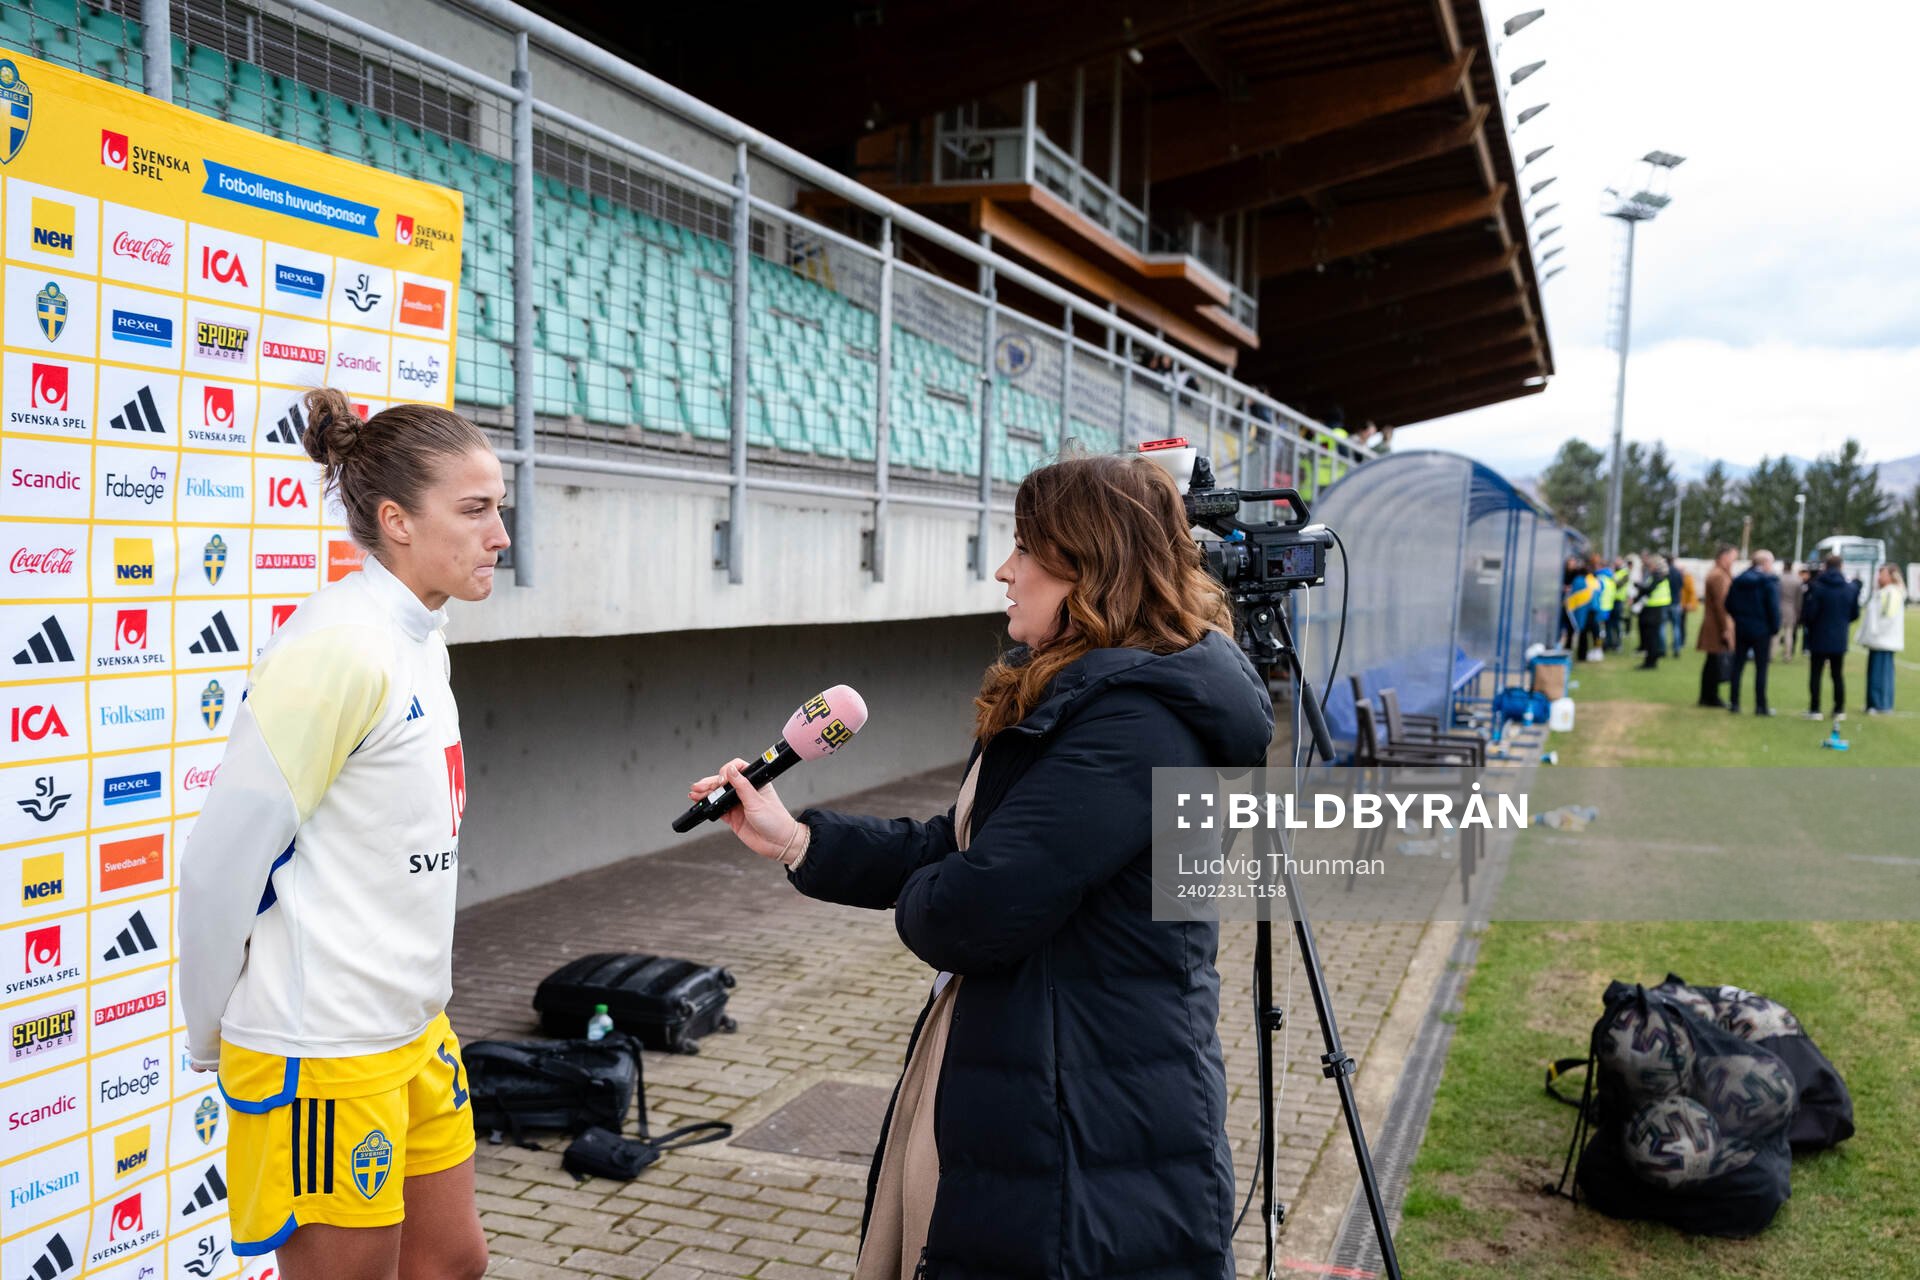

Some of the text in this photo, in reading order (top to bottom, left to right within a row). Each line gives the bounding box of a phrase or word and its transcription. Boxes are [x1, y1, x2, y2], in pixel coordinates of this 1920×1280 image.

[132, 146, 190, 173] SVENSKA
[132, 162, 163, 181] SPEL
[218, 173, 367, 227] Fotbollens huvudsponsor
[414, 239, 434, 251] SPEL
[416, 225, 455, 243] SVENSKA
[202, 246, 248, 287] ICA
[357, 274, 370, 292] SJ
[197, 321, 249, 353] SPORT
[199, 347, 245, 360] BLADET
[264, 342, 325, 364] BAUHAUS
[336, 352, 381, 373] Scandic
[399, 360, 439, 388] Fabege
[11, 413, 86, 429] SVENSKA SPEL
[188, 430, 247, 443] SVENSKA SPEL
[12, 469, 81, 490] Scandic
[106, 473, 164, 504] Fabege
[186, 478, 244, 499] Folksam
[268, 477, 308, 508] ICA
[256, 555, 316, 569] BAUHAUS
[97, 654, 165, 667] SVENSKA SPEL
[11, 704, 69, 742] ICA
[100, 705, 165, 726] Folksam
[35, 776, 54, 797] SJ
[104, 856, 147, 873] Swedbank
[6, 967, 80, 994] SVENSKA SPEL
[95, 991, 166, 1026] BAUHAUS
[12, 1009, 76, 1050] SPORT
[15, 1035, 73, 1058] BLADET
[101, 1071, 159, 1103] Fabege
[8, 1095, 76, 1131] Scandic
[10, 1170, 80, 1208] Folksam
[92, 1230, 161, 1263] SVENSKA SPEL
[198, 1235, 215, 1256] SJ
